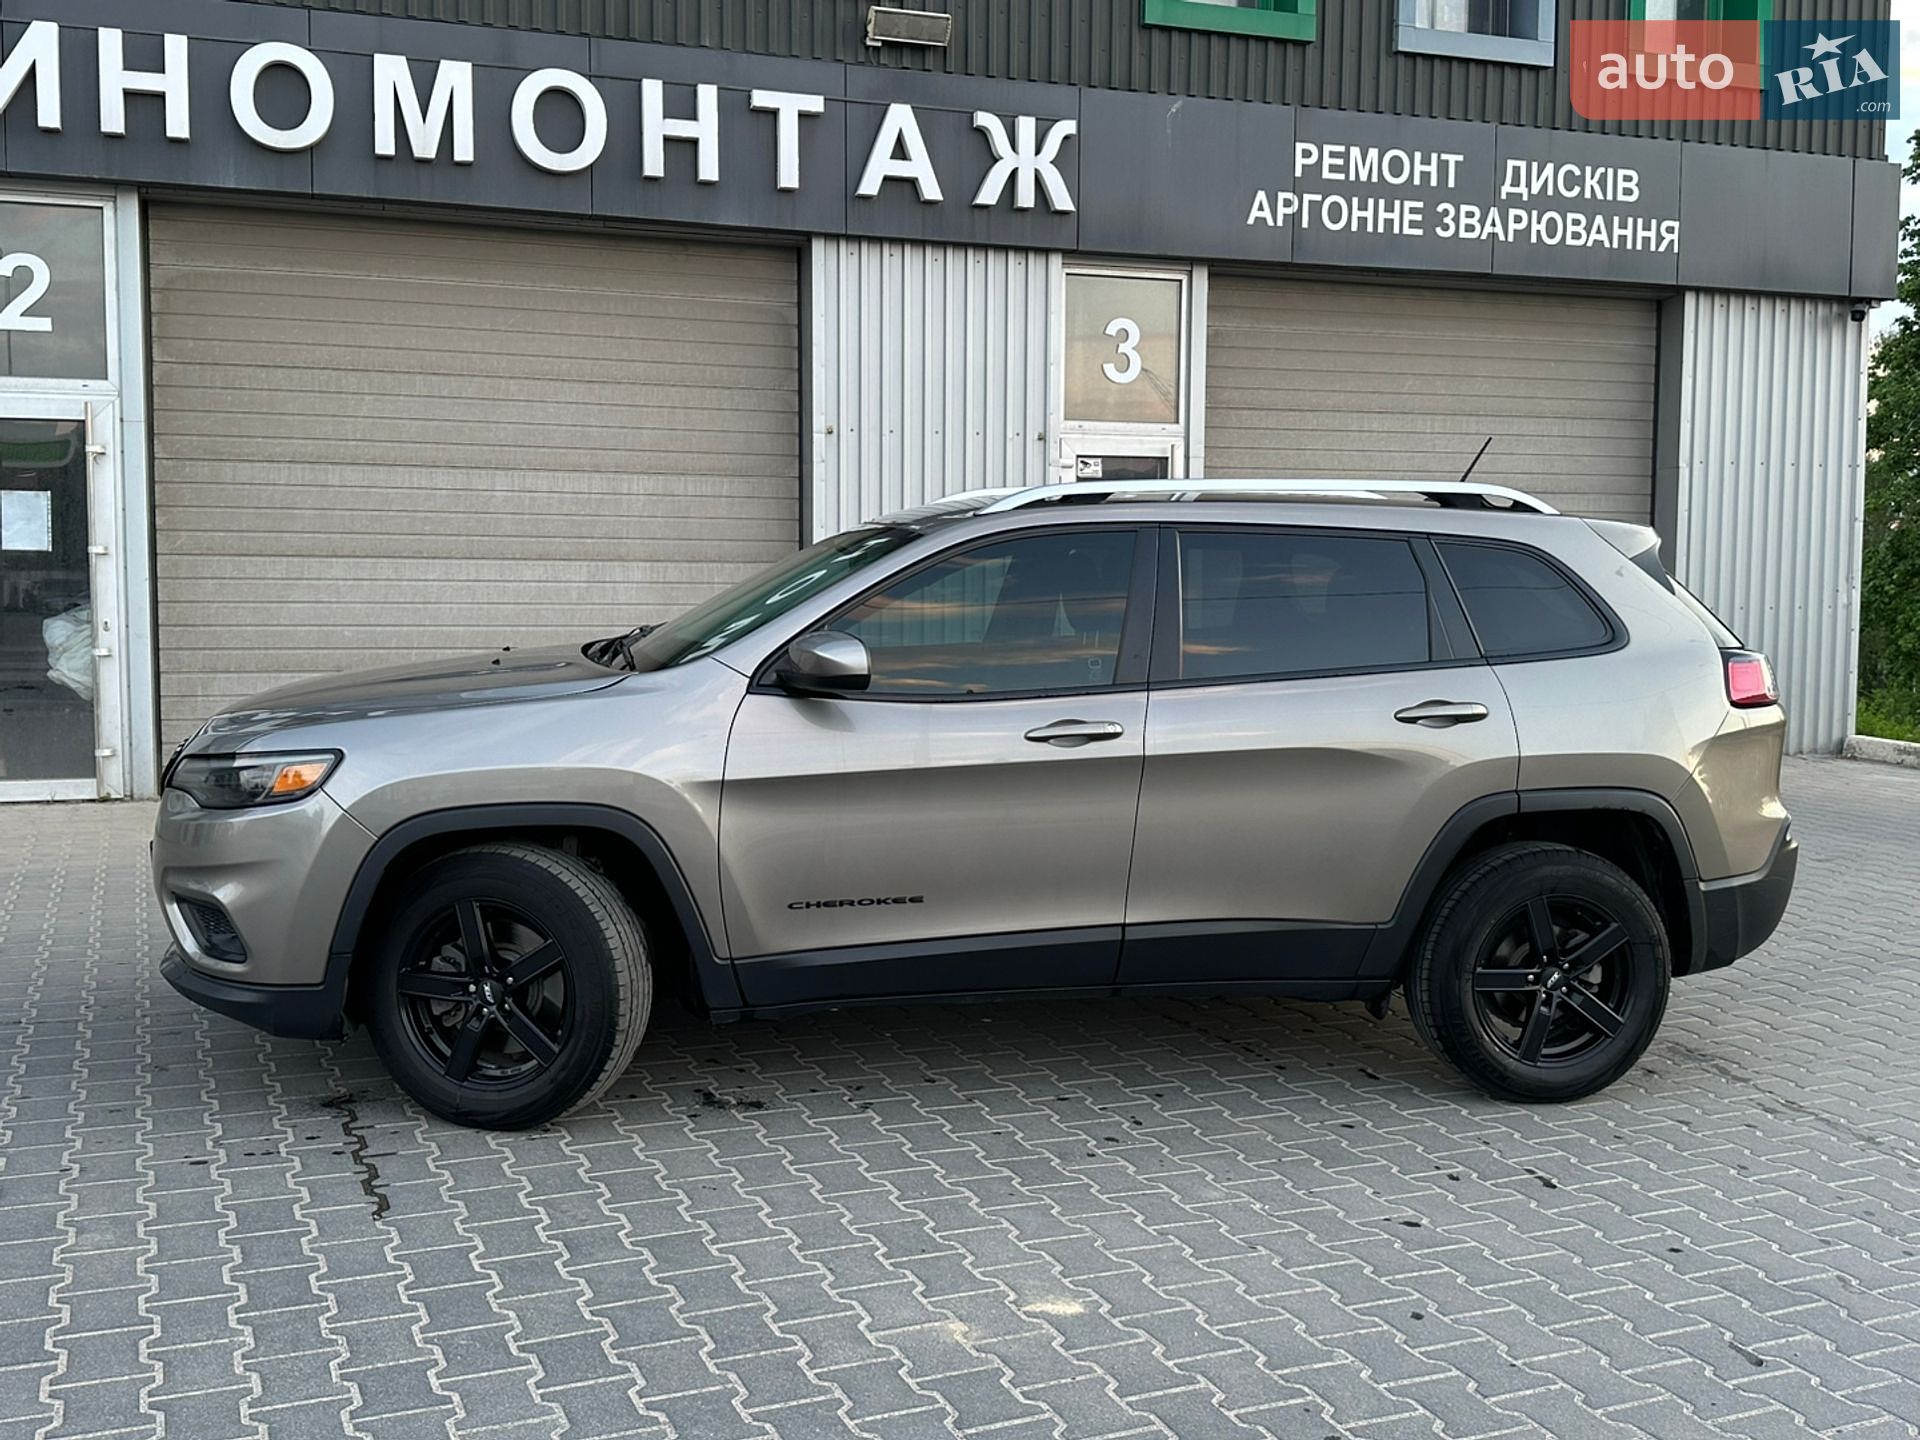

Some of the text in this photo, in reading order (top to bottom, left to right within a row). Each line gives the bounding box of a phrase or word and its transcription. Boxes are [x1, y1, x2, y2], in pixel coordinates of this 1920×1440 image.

[1294, 142, 1640, 202] РЕМОНТ ДИСКІВ
[1247, 190, 1680, 253] АРГОННЕ ЗВАРЮВАННЯ
[0, 252, 52, 332] 2
[1101, 317, 1142, 384] 3
[787, 895, 924, 910] CHEROKEE
